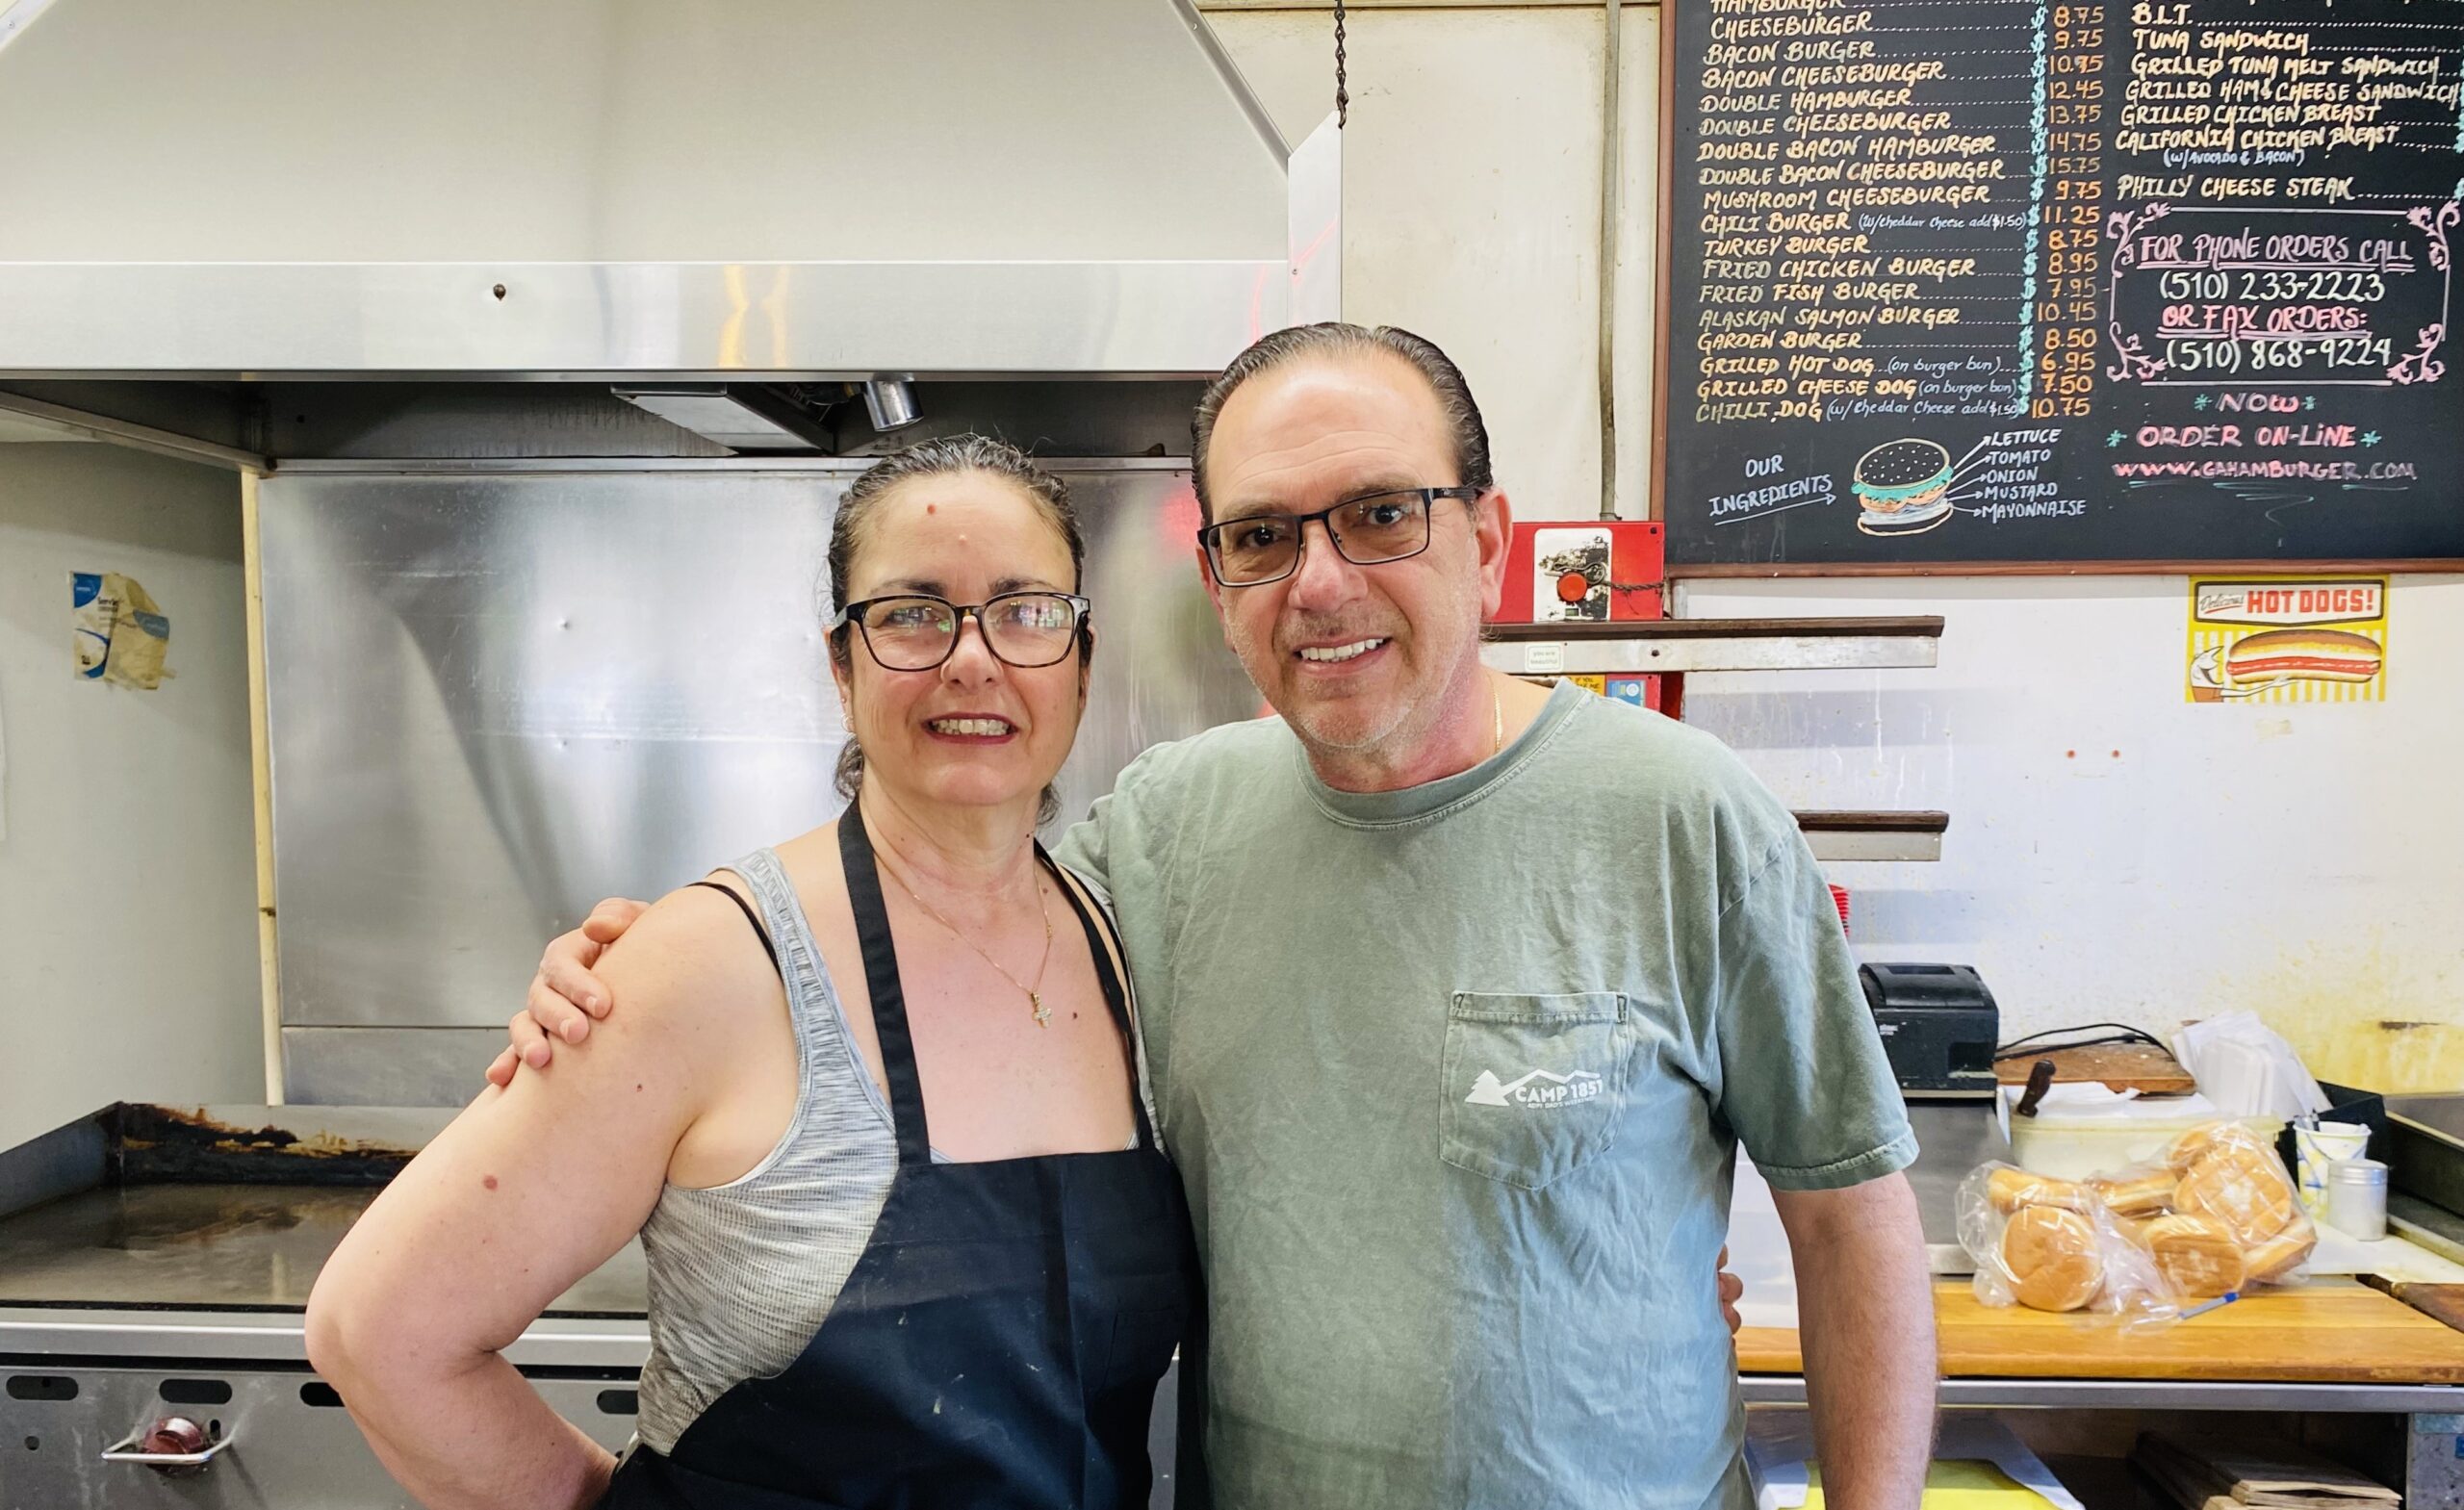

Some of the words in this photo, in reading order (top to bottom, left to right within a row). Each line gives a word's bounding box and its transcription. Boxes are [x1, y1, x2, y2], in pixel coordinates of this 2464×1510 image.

[1710, 11, 1873, 43] CHEESEBURGER
[1703, 40, 1779, 68] BACON
[1784, 40, 1876, 63] BURGER
[2132, 29, 2190, 56] TUNA
[2199, 30, 2309, 58] SANDWICH
[1702, 66, 1777, 94] BACON
[1781, 61, 1946, 90] CHEESEBURGER
[2131, 57, 2223, 82] GRILLED
[2230, 57, 2279, 80] TUNA
[2283, 59, 2333, 78] MELT
[2341, 55, 2439, 85] SANDWICH
[1699, 93, 1782, 113] DOUBLE
[1790, 89, 1912, 115] HAMBURGER
[2125, 80, 2211, 107] GRILLED
[2275, 81, 2350, 106] CHEESE
[2357, 81, 2460, 111] SANDWICH
[1699, 117, 1775, 137] DOUBLE
[1783, 112, 1951, 140] CHEESEBURGER
[2120, 103, 2210, 129] GRILLED
[2213, 102, 2298, 130] CHICKEN
[2299, 102, 2382, 130] BREAST
[1697, 141, 1779, 163] DOUBLE
[1786, 136, 1862, 163] BACON
[1868, 135, 1995, 159] HAMBURGER
[2116, 127, 2234, 155] CALIFORNIA
[2241, 127, 2326, 153] CHICKEN
[2327, 125, 2400, 151] BREAST
[1699, 166, 1775, 186] DOUBLE
[1779, 160, 1846, 187] BACON
[1847, 158, 2006, 185] CHEESEBURGER
[1703, 190, 1817, 213] MUSHROOM
[1827, 186, 1991, 212] CHEESEBURGER
[2117, 174, 2194, 200] PHILLY
[2200, 177, 2277, 201] CHEESE
[2286, 177, 2355, 204] STEAK
[1701, 214, 1761, 239] CHILI
[1766, 212, 1851, 234] BURGER
[1704, 237, 1783, 258] TURKEY
[1786, 234, 1873, 259] BURGER
[2139, 236, 2183, 261] FOR
[2193, 226, 2260, 270] PHONE
[2266, 235, 2349, 263] ORDERS
[2360, 240, 2414, 270] CALL
[1702, 259, 1771, 279] FRIED
[1779, 257, 1883, 282] CHICKEN
[1887, 258, 1975, 282] BURGER
[1699, 284, 1763, 304] FRIED
[1772, 283, 1825, 305] FISH
[1833, 282, 1921, 305] BURGER
[2160, 270, 2228, 299] (510)
[2241, 272, 2385, 301] 233-2223
[1699, 306, 1787, 332] ALASKAN
[1794, 305, 1878, 330] SALMON
[1878, 307, 1961, 330] BURGER
[2163, 306, 2198, 328] OR
[2202, 304, 2258, 339] FAX
[2268, 305, 2368, 332] ORDERS:
[1697, 329, 1778, 354] GARDEN
[1780, 331, 1862, 353] BURGER
[1699, 356, 1781, 378] GRILLED
[1787, 355, 1832, 381] HOT
[1833, 356, 1875, 377] DOG
[1913, 358, 1963, 378] burger
[2167, 339, 2241, 373] (510)
[2251, 338, 2392, 369] 868-9224
[1697, 378, 1787, 401] GRILLED
[1797, 379, 1869, 404] CHEESE
[1875, 379, 1917, 400] DOG
[1942, 379, 1988, 401] burger
[1774, 400, 1822, 422] DOG
[1990, 428, 2062, 447] LETTUCE
[2137, 424, 2242, 447] ORDER
[1745, 454, 1784, 477] OUR
[1989, 448, 2051, 466] TOMATO
[1987, 466, 2039, 483] ONION
[1709, 473, 1834, 517] INGREDIENTS
[1984, 482, 2058, 500] MUSTARD
[1982, 499, 2087, 524] MAYONNAISE
[2247, 590, 2295, 613] HOT
[2299, 589, 2374, 613] DOGS!
[1515, 1087, 1568, 1103] CAMP
